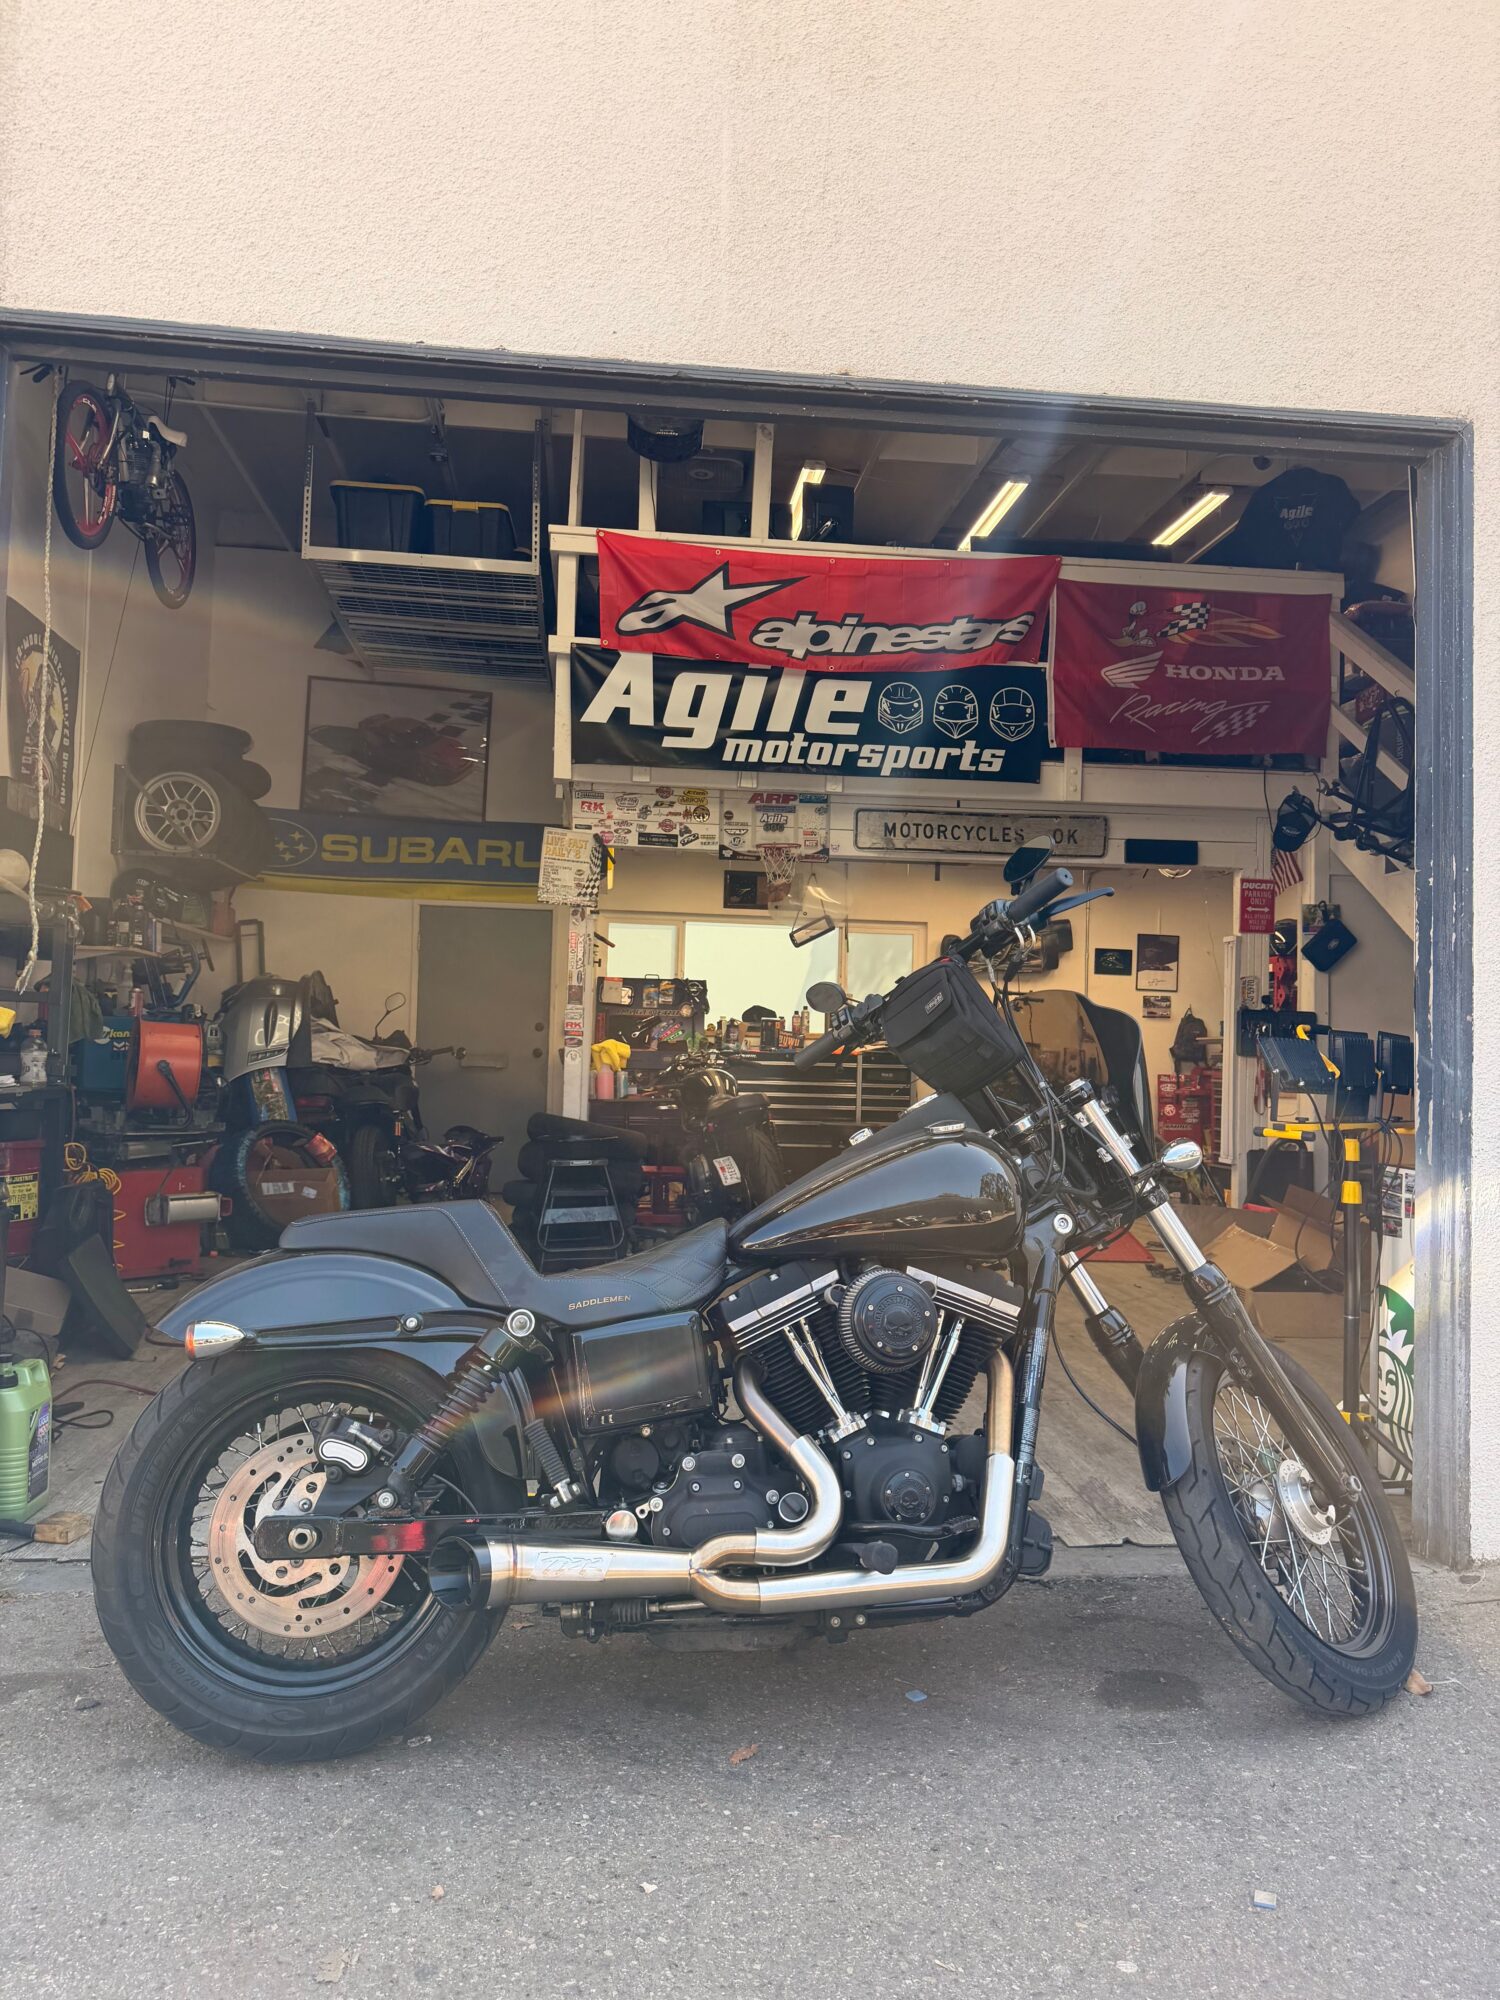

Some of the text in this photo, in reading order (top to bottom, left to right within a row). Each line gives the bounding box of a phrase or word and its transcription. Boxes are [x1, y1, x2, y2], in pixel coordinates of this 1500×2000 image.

[1280, 505, 1313, 520] Agile
[751, 612, 1035, 659] alpinestars
[1164, 664, 1285, 681] HONDA
[580, 651, 872, 748] Agile
[1110, 692, 1271, 733] Racing
[722, 732, 1005, 776] motorsports
[747, 793, 799, 804] ARP
[580, 801, 605, 812] RK
[760, 813, 788, 824] Agile
[884, 822, 1078, 845] MOTORCYCLES OK
[1242, 882, 1274, 890] DUCATI
[1244, 890, 1272, 899] PARKING
[568, 1295, 631, 1310] SADDLEMEN
